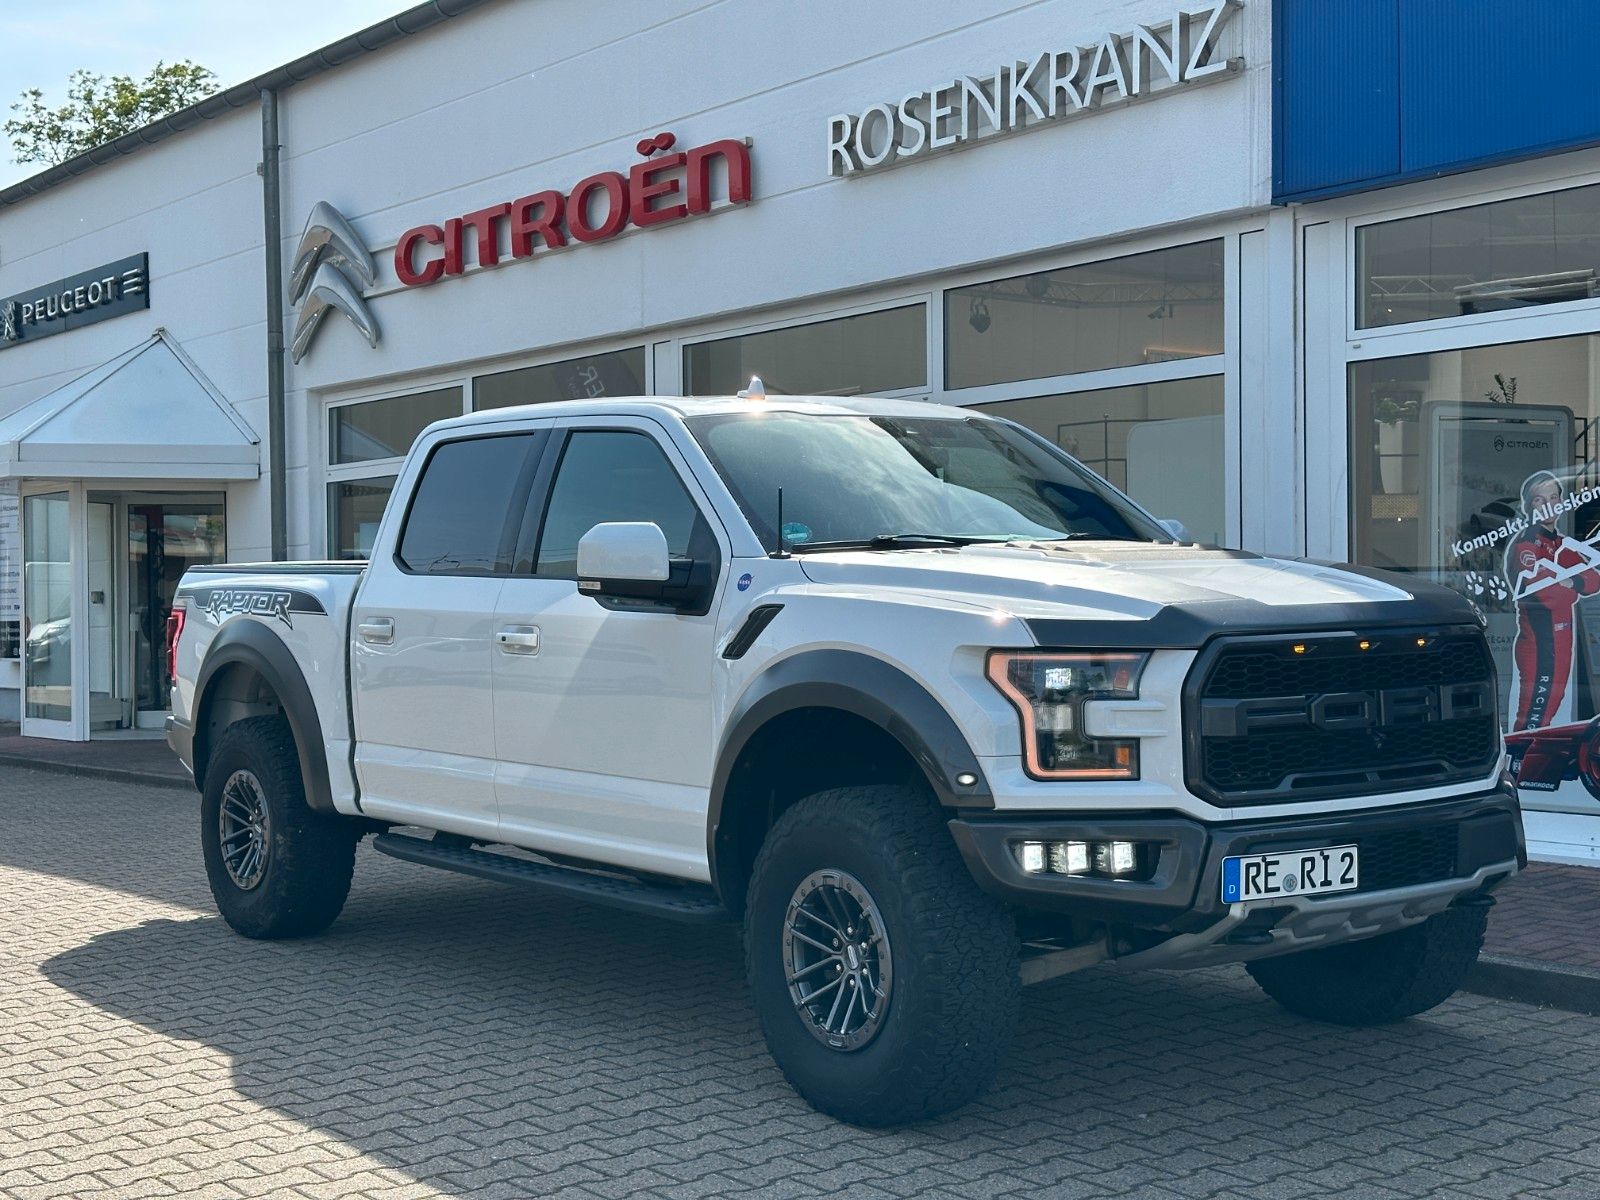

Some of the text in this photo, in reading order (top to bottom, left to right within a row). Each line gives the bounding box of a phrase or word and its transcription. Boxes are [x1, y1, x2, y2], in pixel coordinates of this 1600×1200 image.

[827, 0, 1236, 177] ROSENKRANZ
[22, 276, 116, 325] PEUGEOT
[1451, 518, 1529, 557] Kompakt.
[205, 590, 294, 631] RAPTOR
[1202, 684, 1483, 737] FORD
[1527, 675, 1549, 730] RACING
[1228, 884, 1236, 894] D
[1245, 852, 1354, 895] RE RI 2
